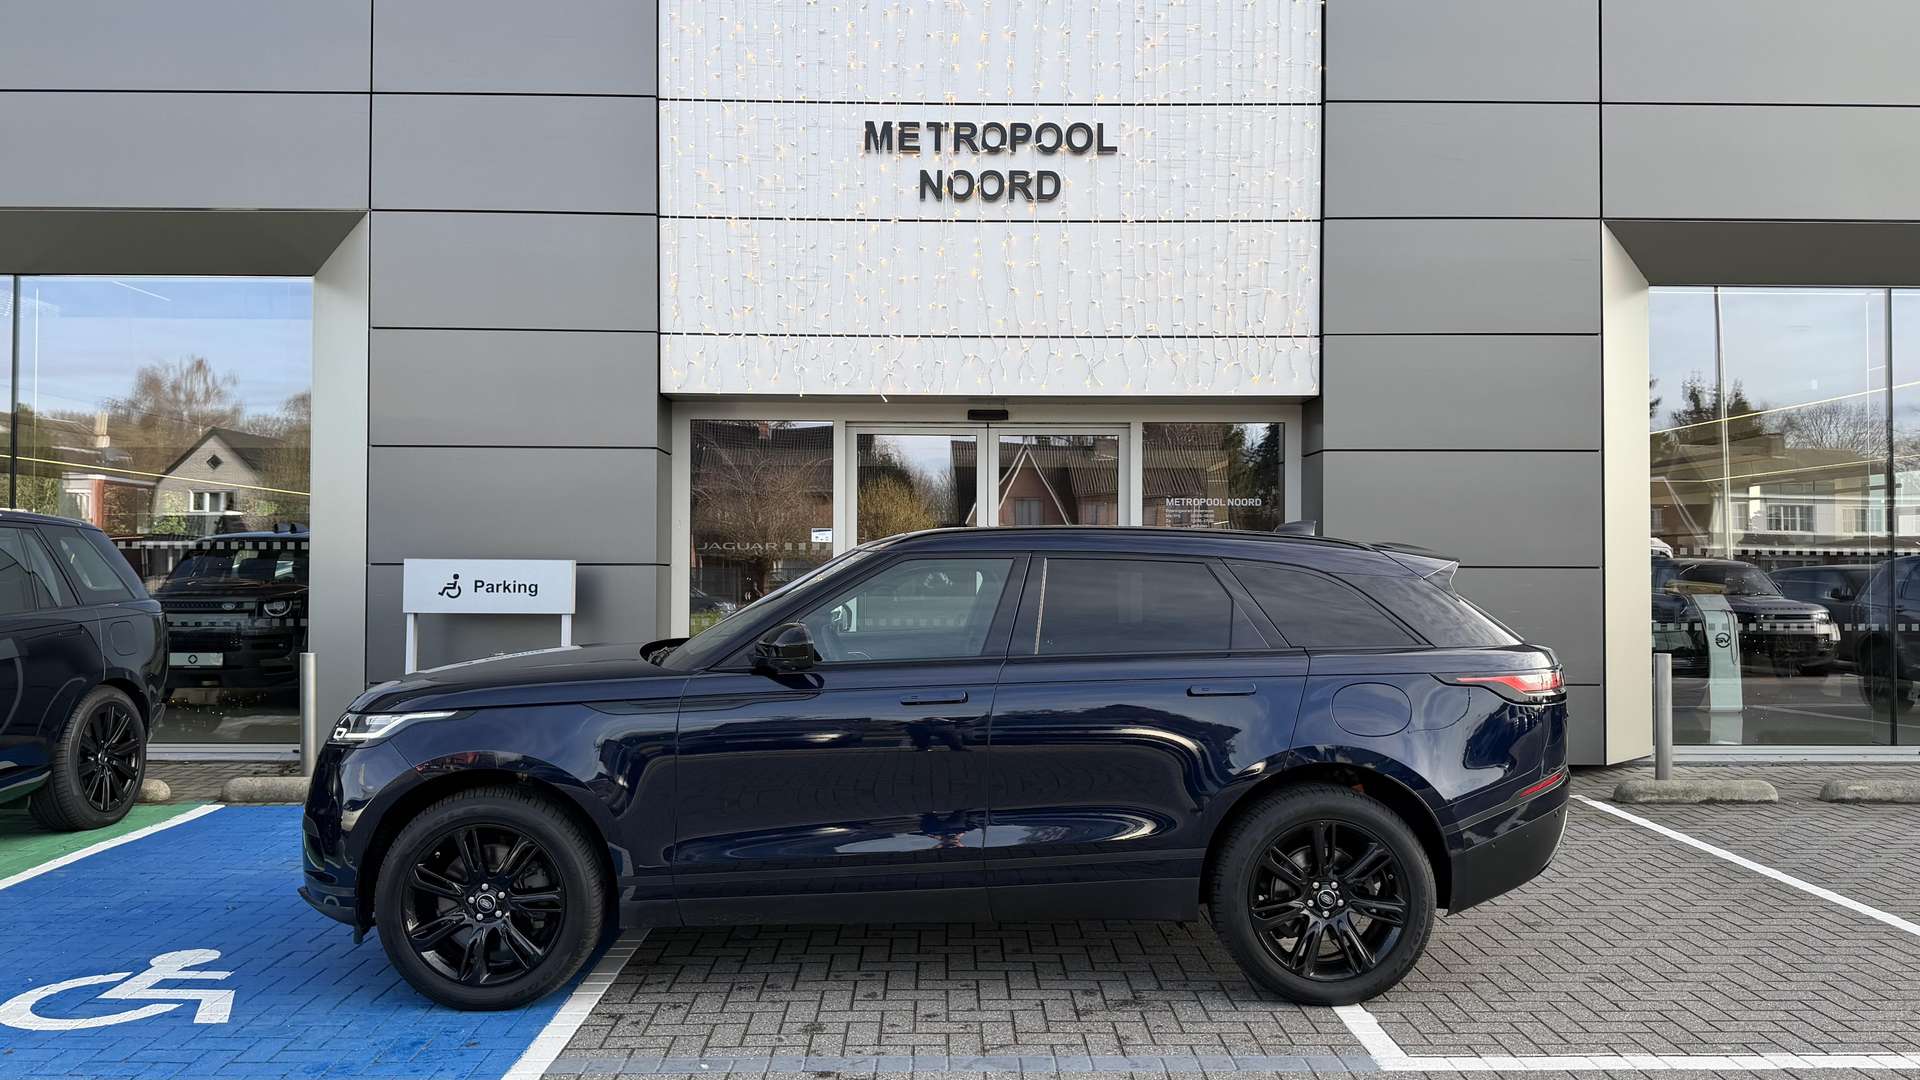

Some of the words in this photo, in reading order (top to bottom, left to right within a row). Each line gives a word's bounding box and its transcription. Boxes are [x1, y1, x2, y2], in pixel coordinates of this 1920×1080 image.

[864, 121, 1118, 155] METROPOOL
[919, 169, 1061, 203] NOORD
[1165, 497, 1226, 507] METROPOOL
[1227, 497, 1262, 507] NOORD
[699, 542, 778, 551] JAGUAR
[474, 579, 538, 597] Parking
